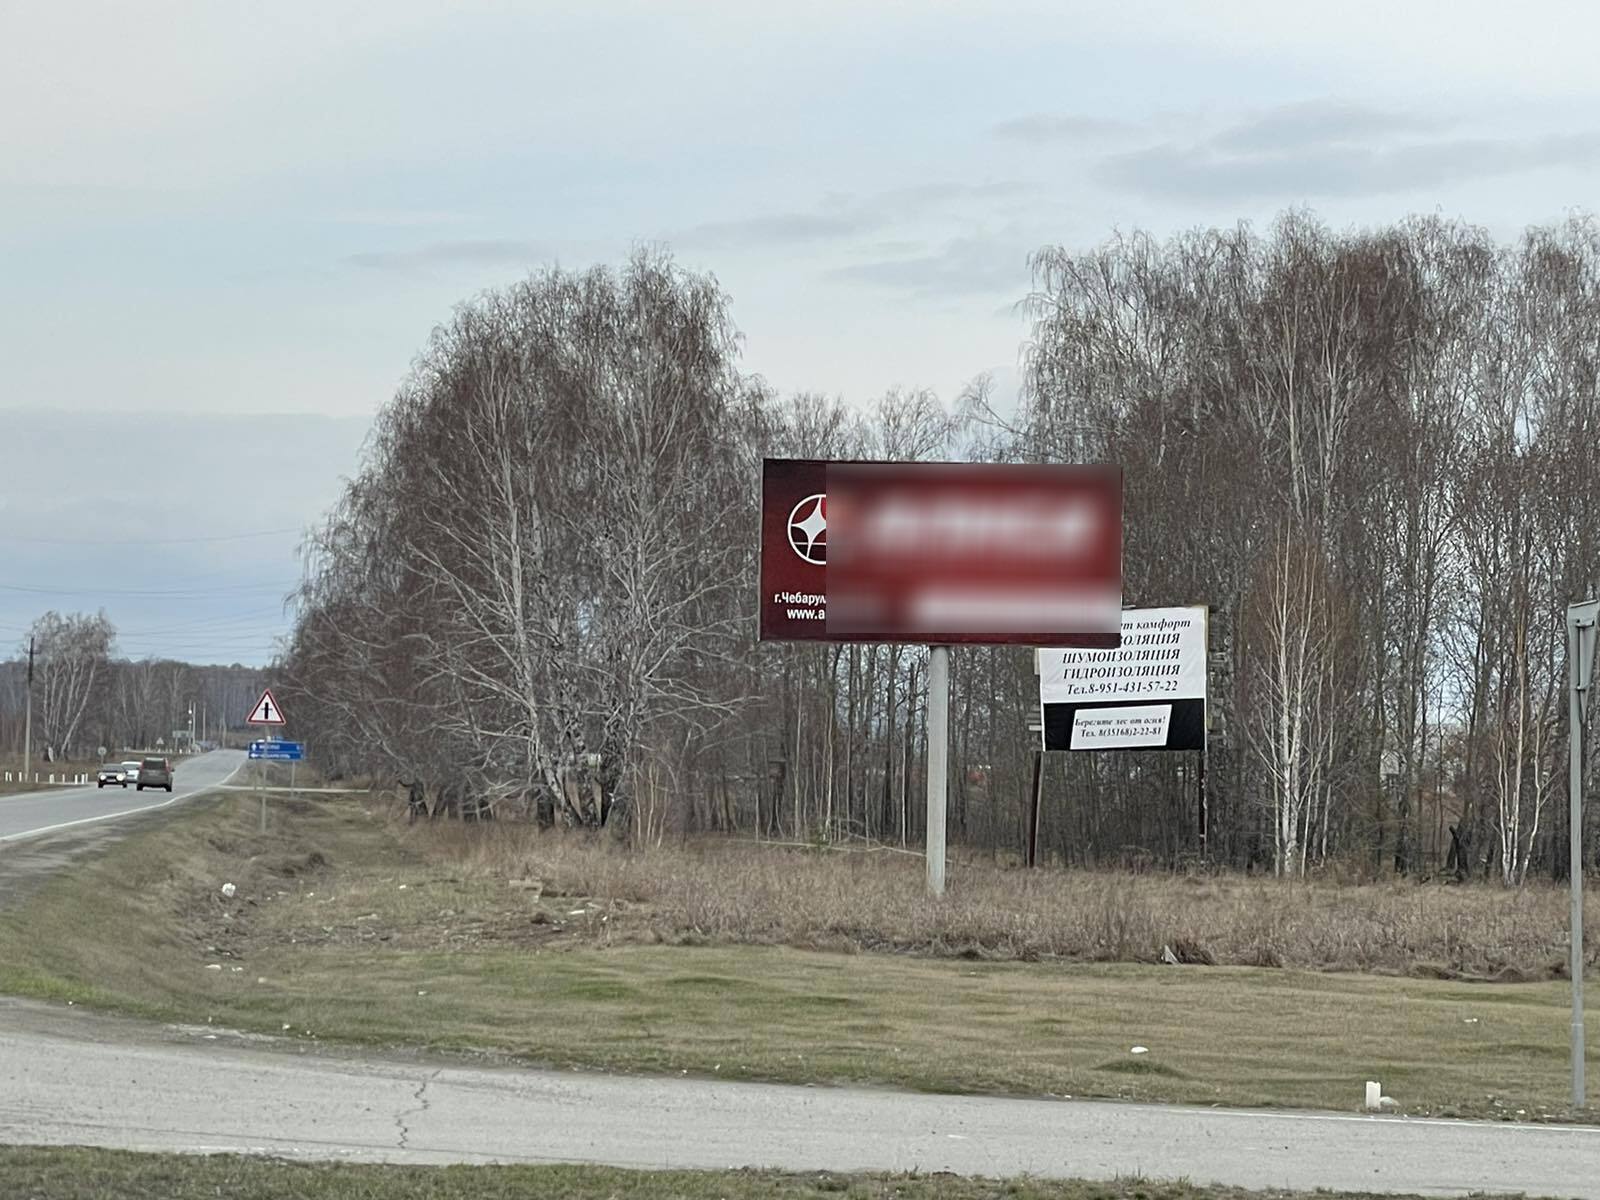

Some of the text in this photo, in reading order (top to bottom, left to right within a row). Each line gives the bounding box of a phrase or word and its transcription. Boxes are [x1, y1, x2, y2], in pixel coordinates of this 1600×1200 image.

[1136, 618, 1191, 631] комфорт
[1121, 633, 1180, 646] ОЛЯЦИЯ
[1062, 648, 1181, 664] ШУМОИЗОЛЯЦИЯ
[1063, 664, 1181, 680] ГИДРОИЗОЛЯЦИЯ
[1075, 718, 1113, 728] Берегите
